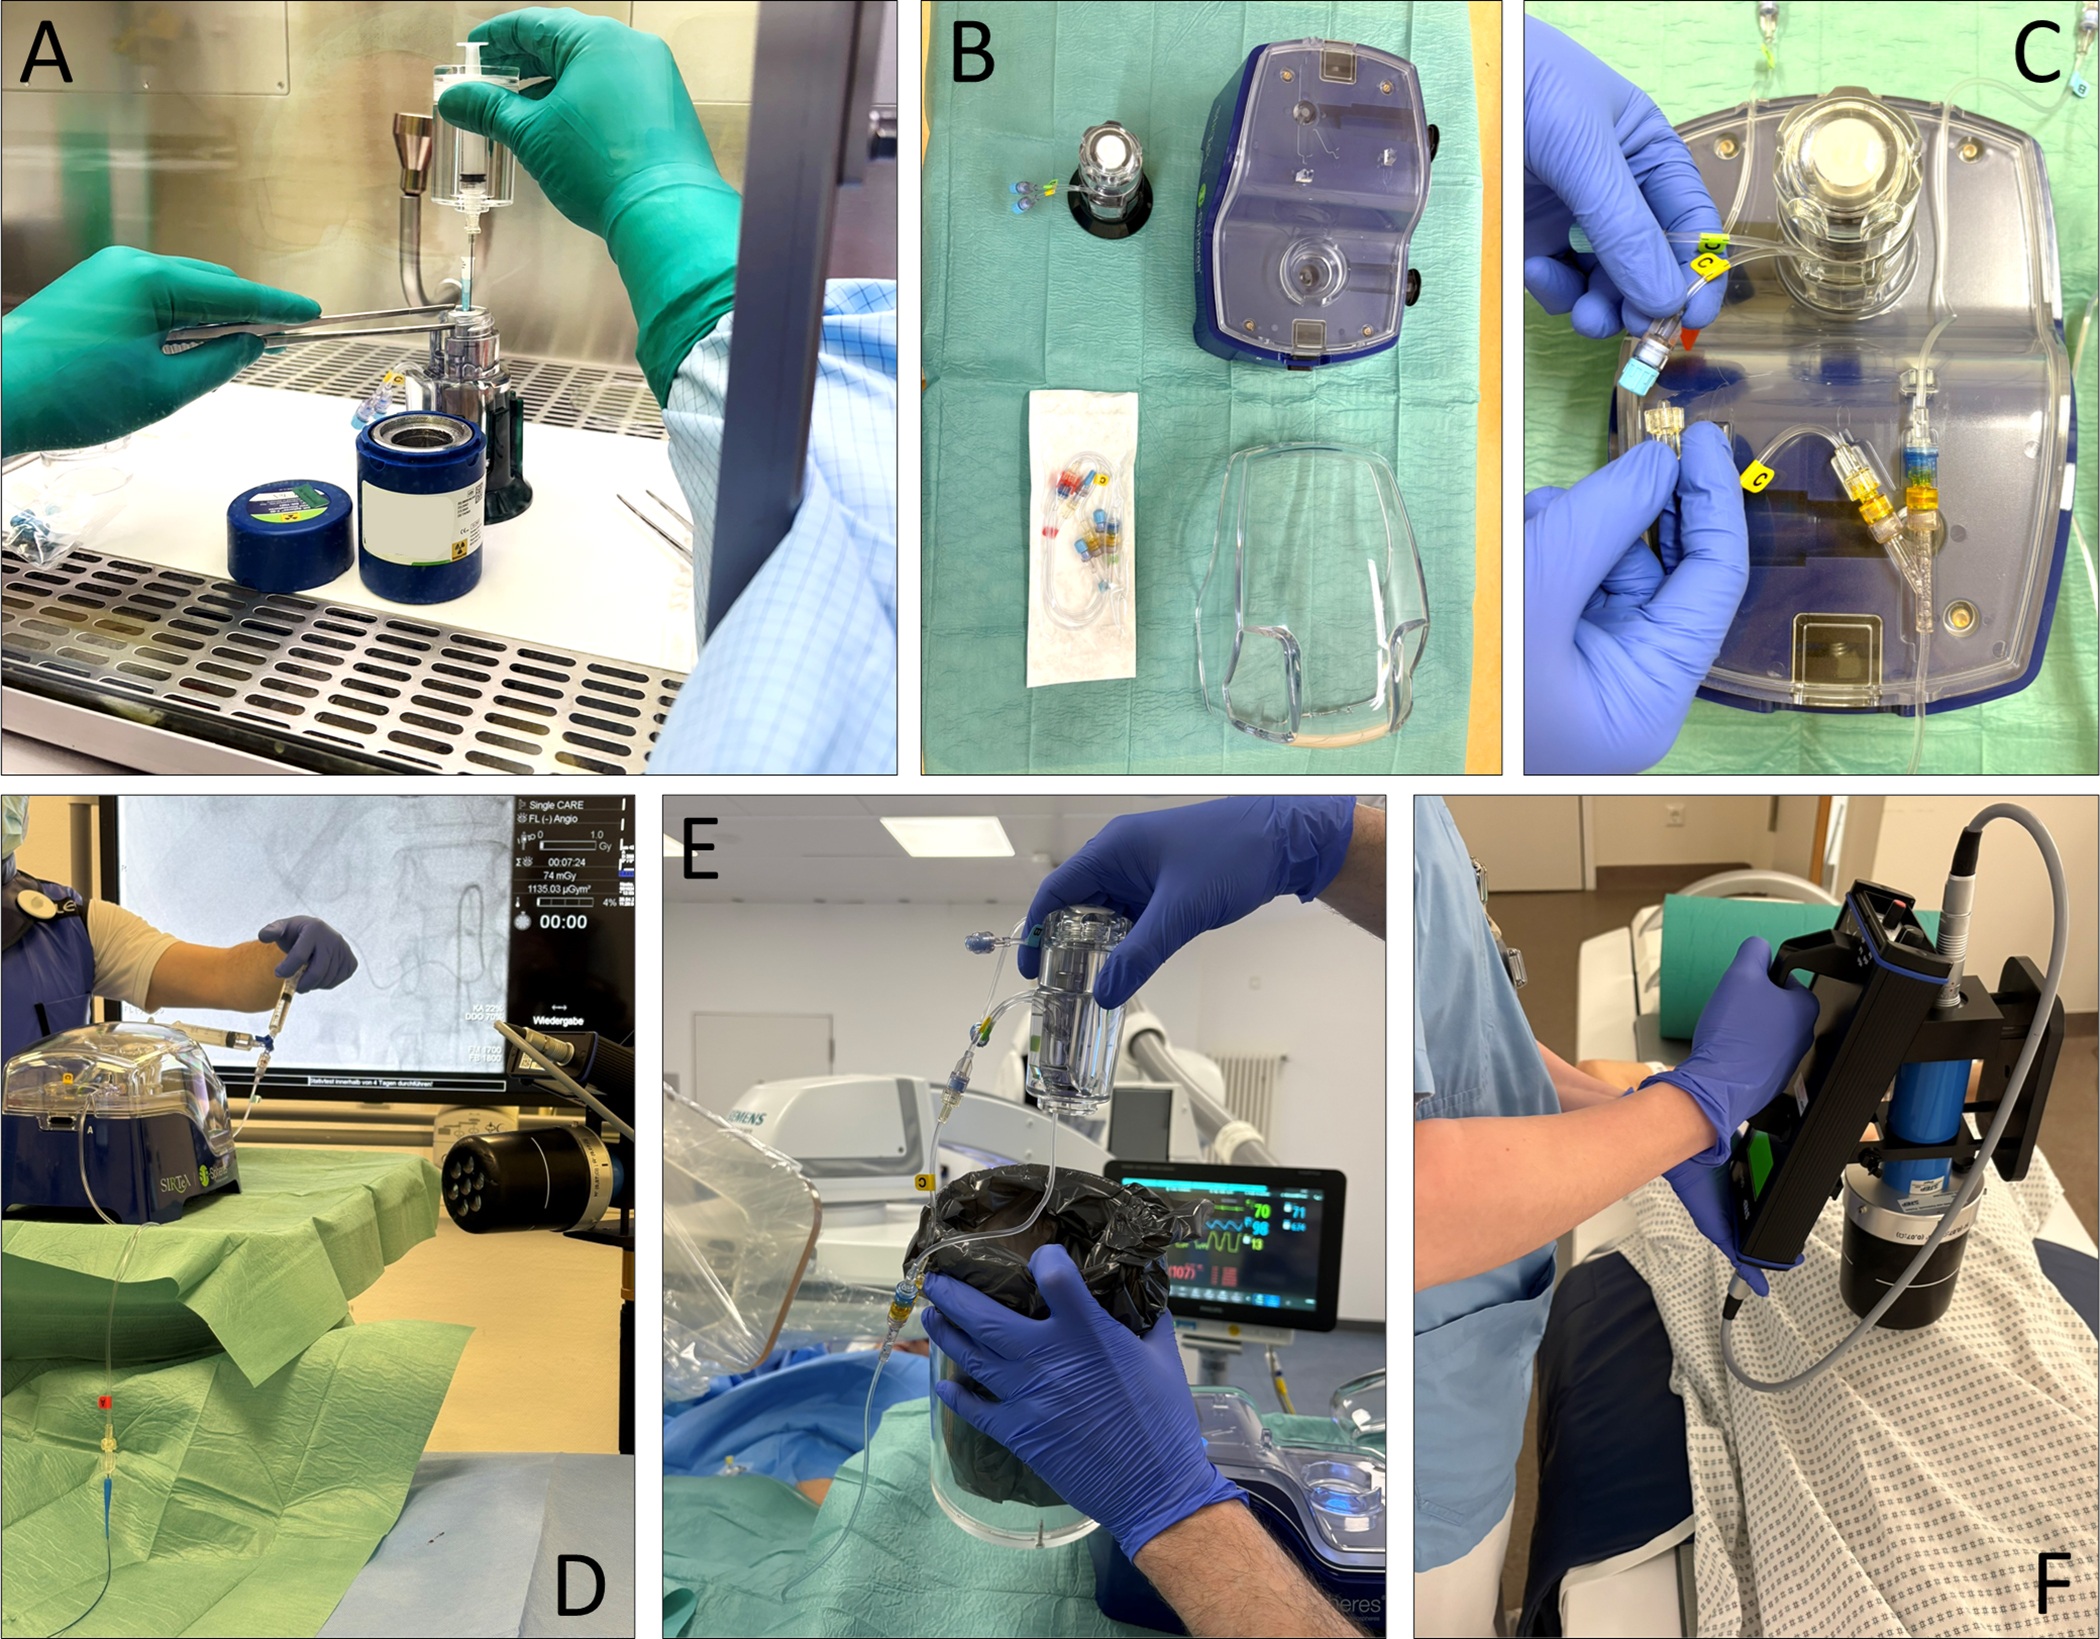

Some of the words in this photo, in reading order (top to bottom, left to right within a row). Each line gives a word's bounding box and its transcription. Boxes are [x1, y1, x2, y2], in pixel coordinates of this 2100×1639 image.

[1698, 257, 1713, 268] C
[1753, 473, 1768, 486] C
[529, 800, 555, 812] Single
[557, 800, 584, 810] CARE
[529, 815, 540, 823] FL
[554, 815, 578, 825] Angio
[537, 830, 544, 839] 0
[591, 830, 604, 839] 1.0
[599, 842, 612, 852] Gy
[548, 858, 586, 867] 00:07:24
[543, 871, 554, 879] 74
[556, 871, 576, 882] mGy
[528, 885, 561, 893] 1135.03
[602, 898, 617, 907] 4%
[540, 914, 587, 929] 00:00
[533, 1015, 584, 1027] Wiedergabe
[335, 1078, 361, 1086] innerhalb
[379, 1079, 397, 1088] Tagen
[87, 1126, 94, 1134] A
[918, 1177, 927, 1188] C
[1254, 1203, 1272, 1219] 70
[1292, 1205, 1306, 1219] 71
